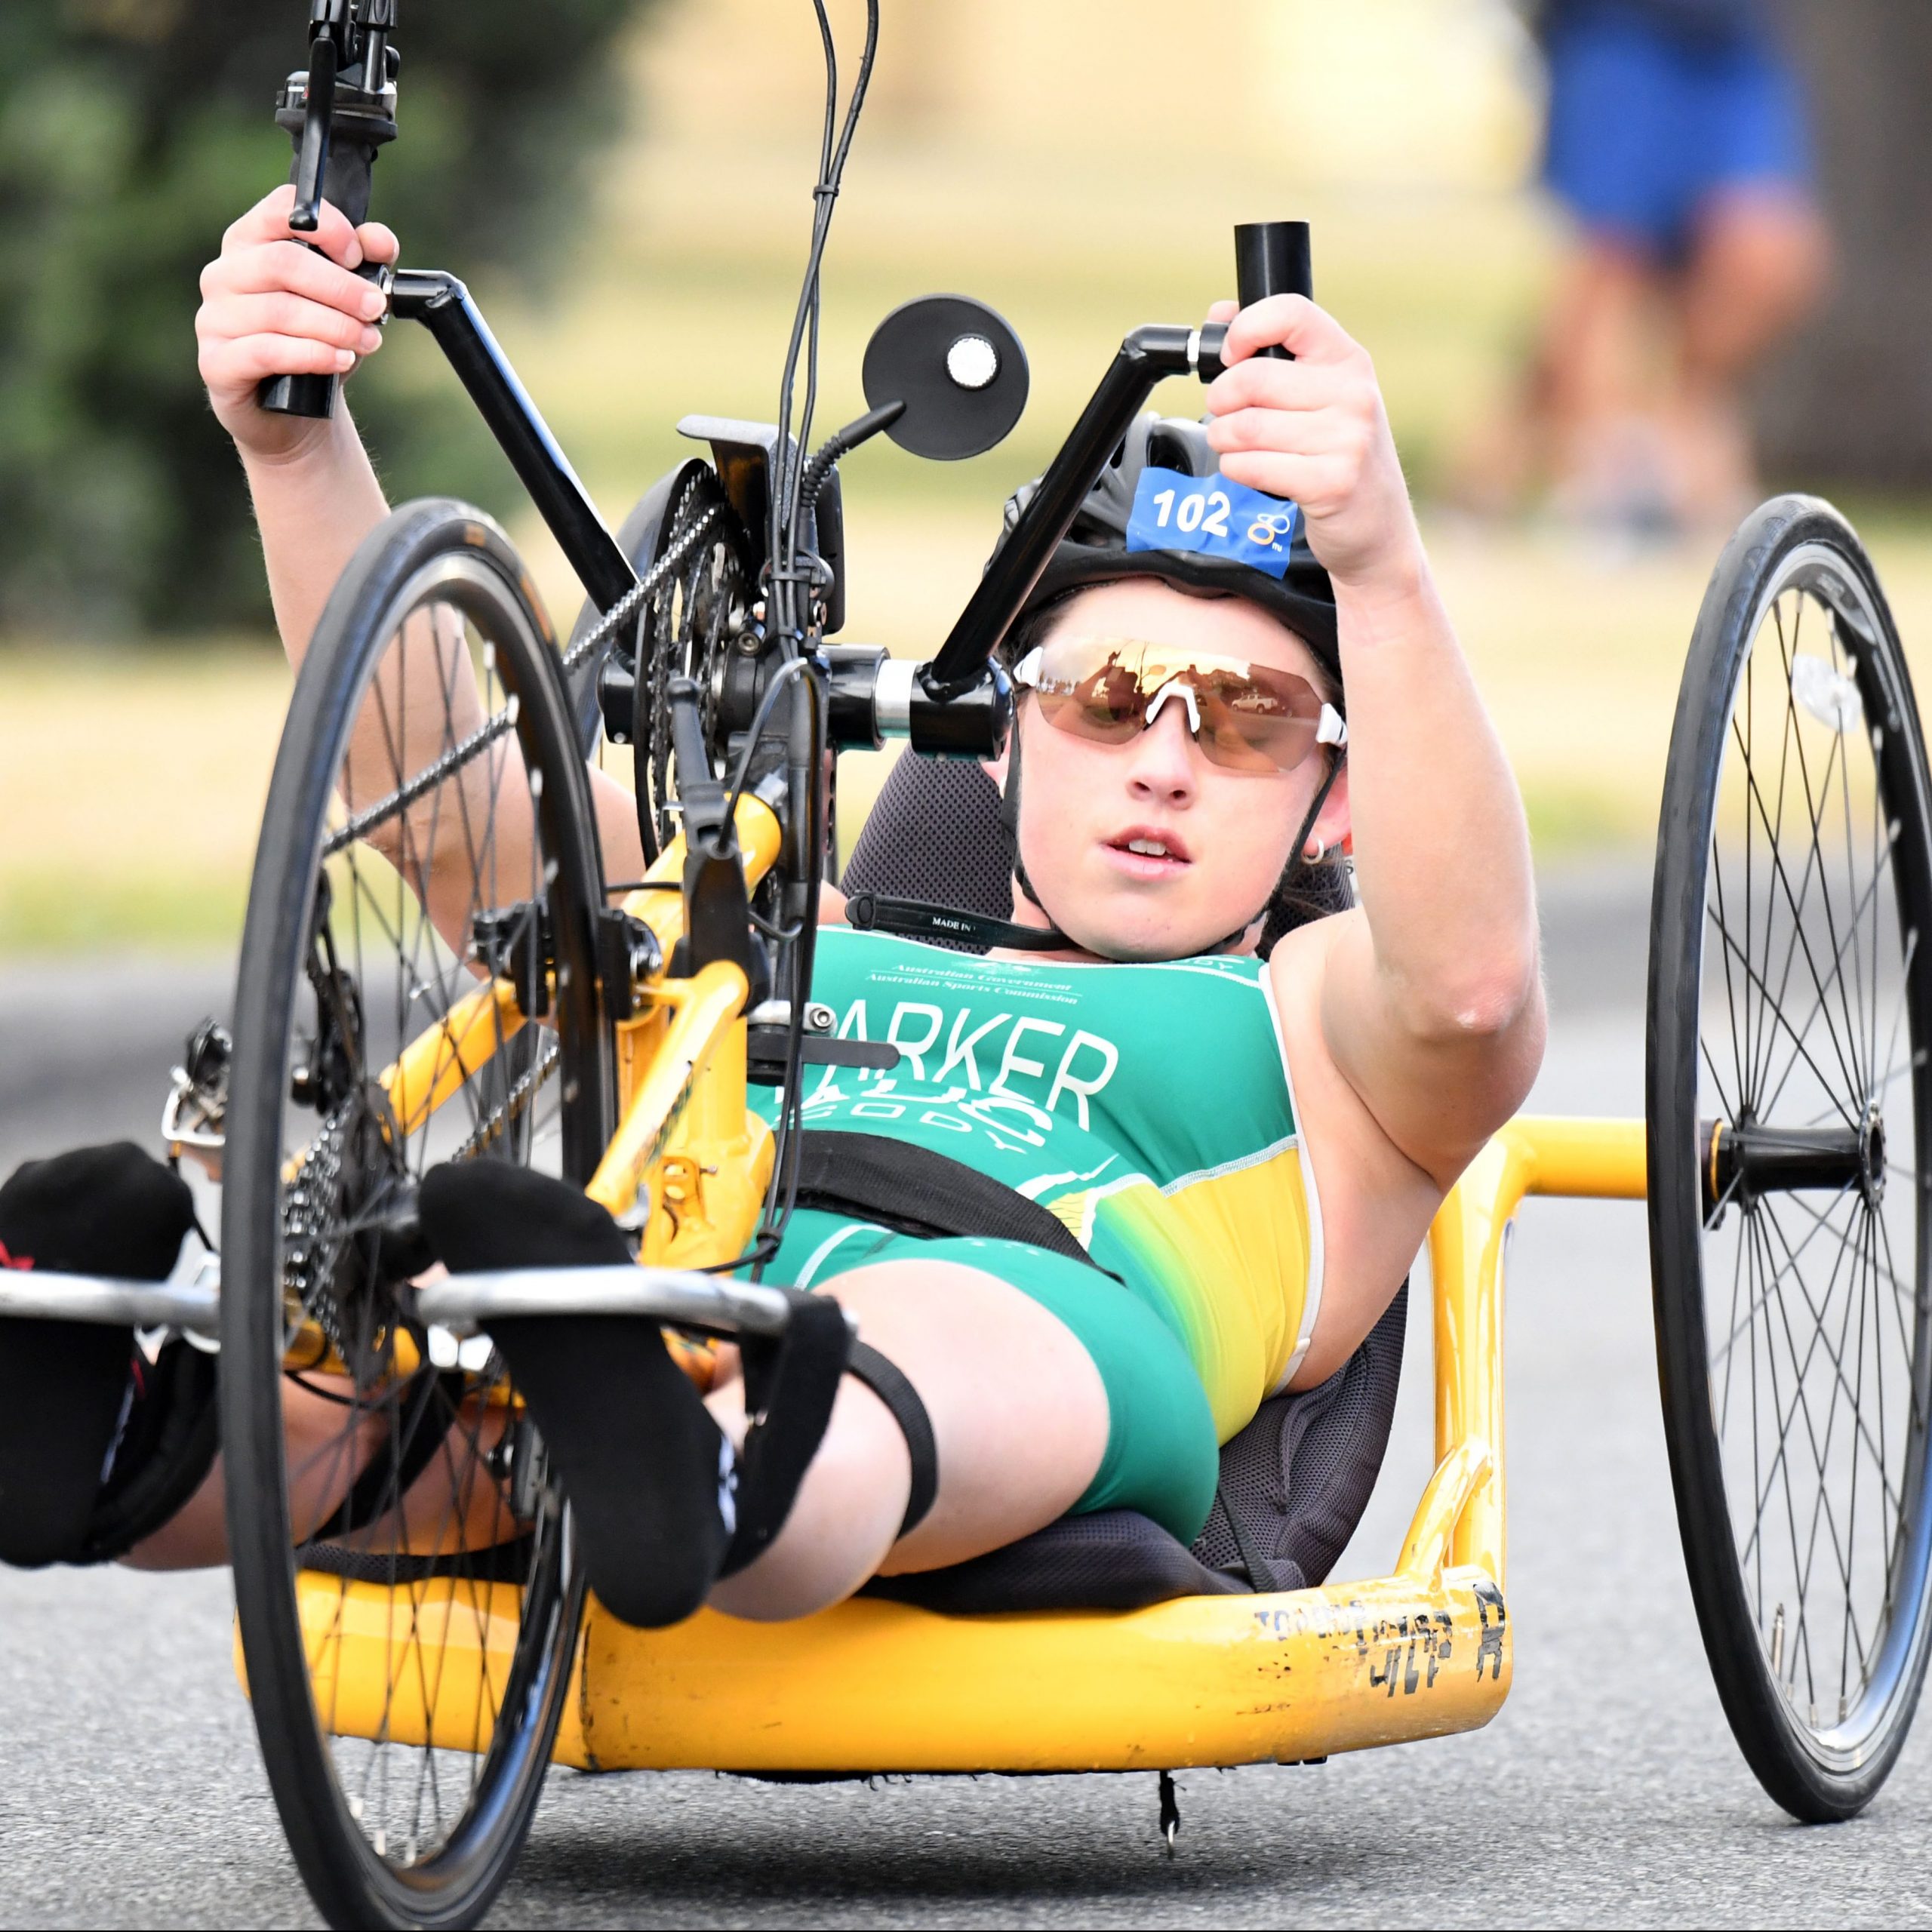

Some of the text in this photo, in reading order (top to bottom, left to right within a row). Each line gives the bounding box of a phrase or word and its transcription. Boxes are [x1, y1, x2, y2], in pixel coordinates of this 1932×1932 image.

[1152, 489, 1231, 537] 102
[932, 916, 959, 931] MADE
[961, 923, 971, 932] IN
[866, 973, 1078, 1004] Australian Sports Commission
[891, 964, 1072, 991] Australian Government
[774, 999, 1118, 1132] ARKER
